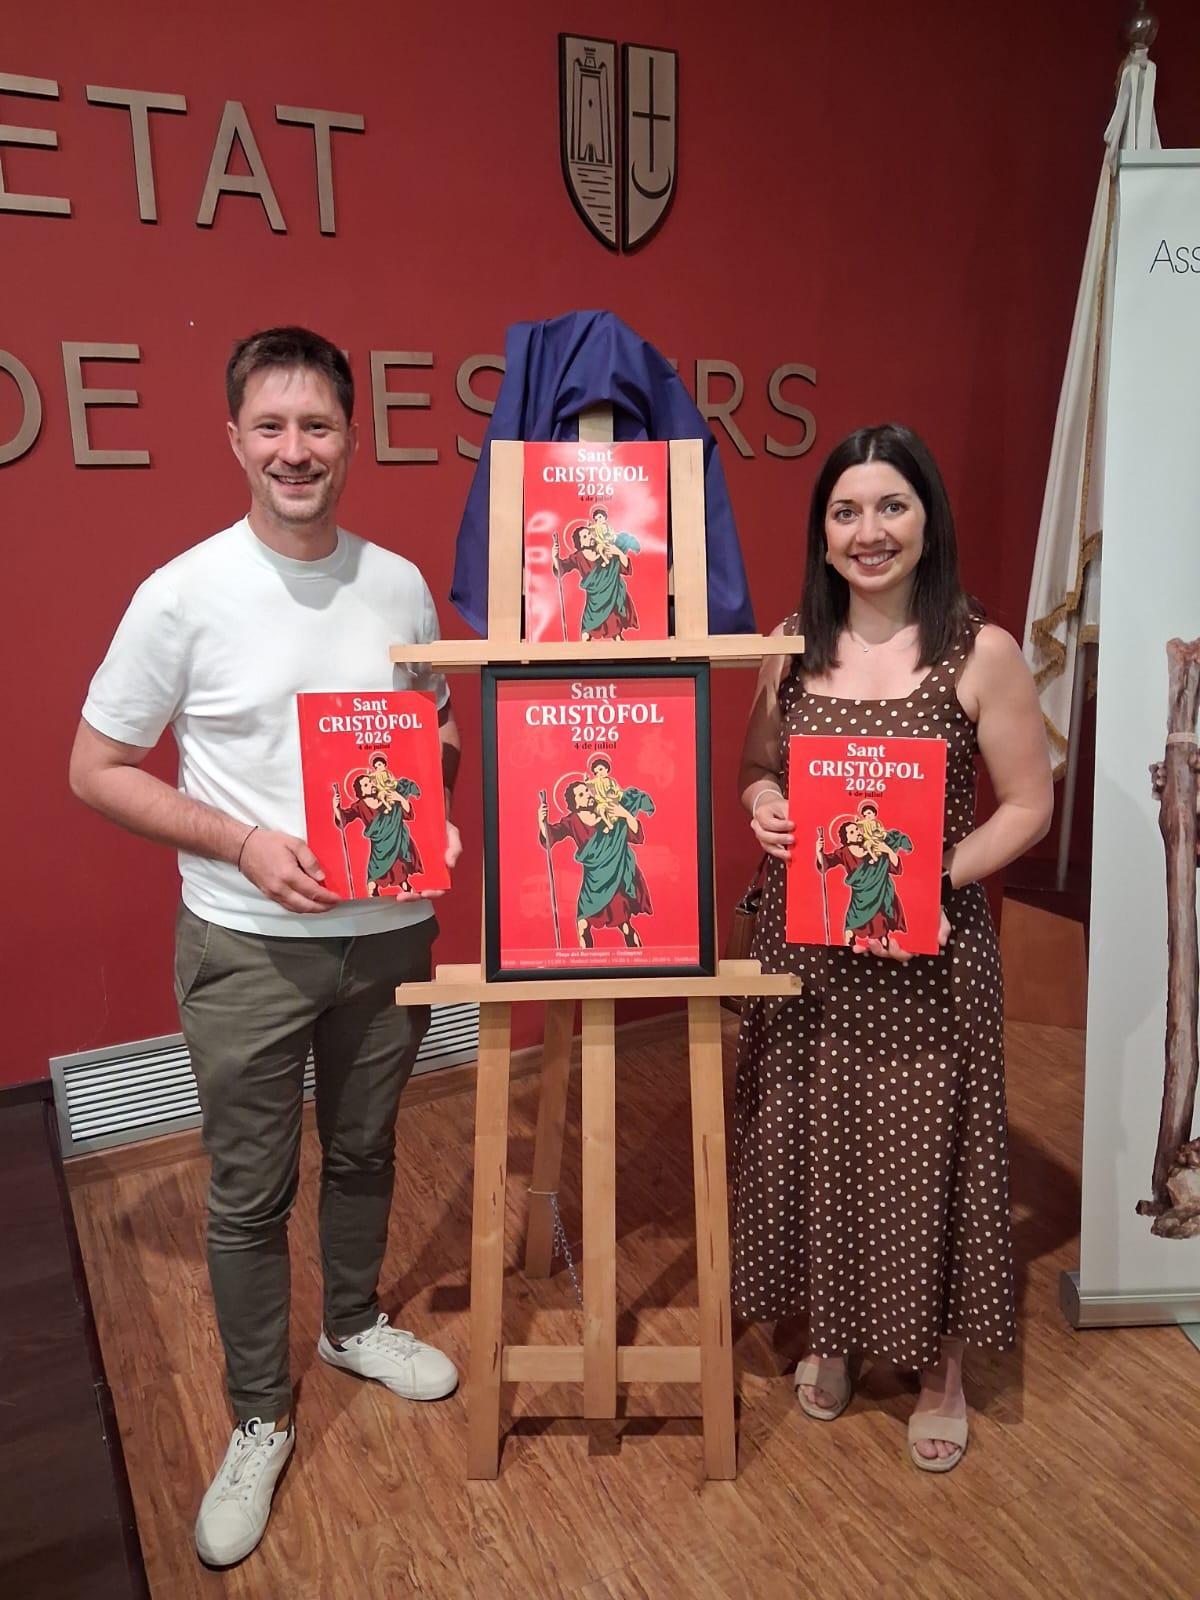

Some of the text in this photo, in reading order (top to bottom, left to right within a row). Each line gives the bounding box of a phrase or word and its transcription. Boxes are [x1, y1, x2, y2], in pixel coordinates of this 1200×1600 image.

[577, 448, 614, 462] Sant
[543, 462, 649, 482] CRISTÒFOL
[577, 483, 614, 496] 2026
[571, 682, 617, 700] Sant
[353, 697, 387, 711] Sant
[525, 699, 664, 725] CRISTÒFOL
[318, 709, 422, 732] CRISTÒFOL
[355, 731, 392, 744] 2026
[571, 726, 619, 741] 2026
[581, 742, 592, 750] de
[594, 742, 617, 751] juliol
[847, 742, 885, 757] Sant
[808, 757, 924, 779] CRISTÒFOL
[845, 778, 886, 792] 2026
